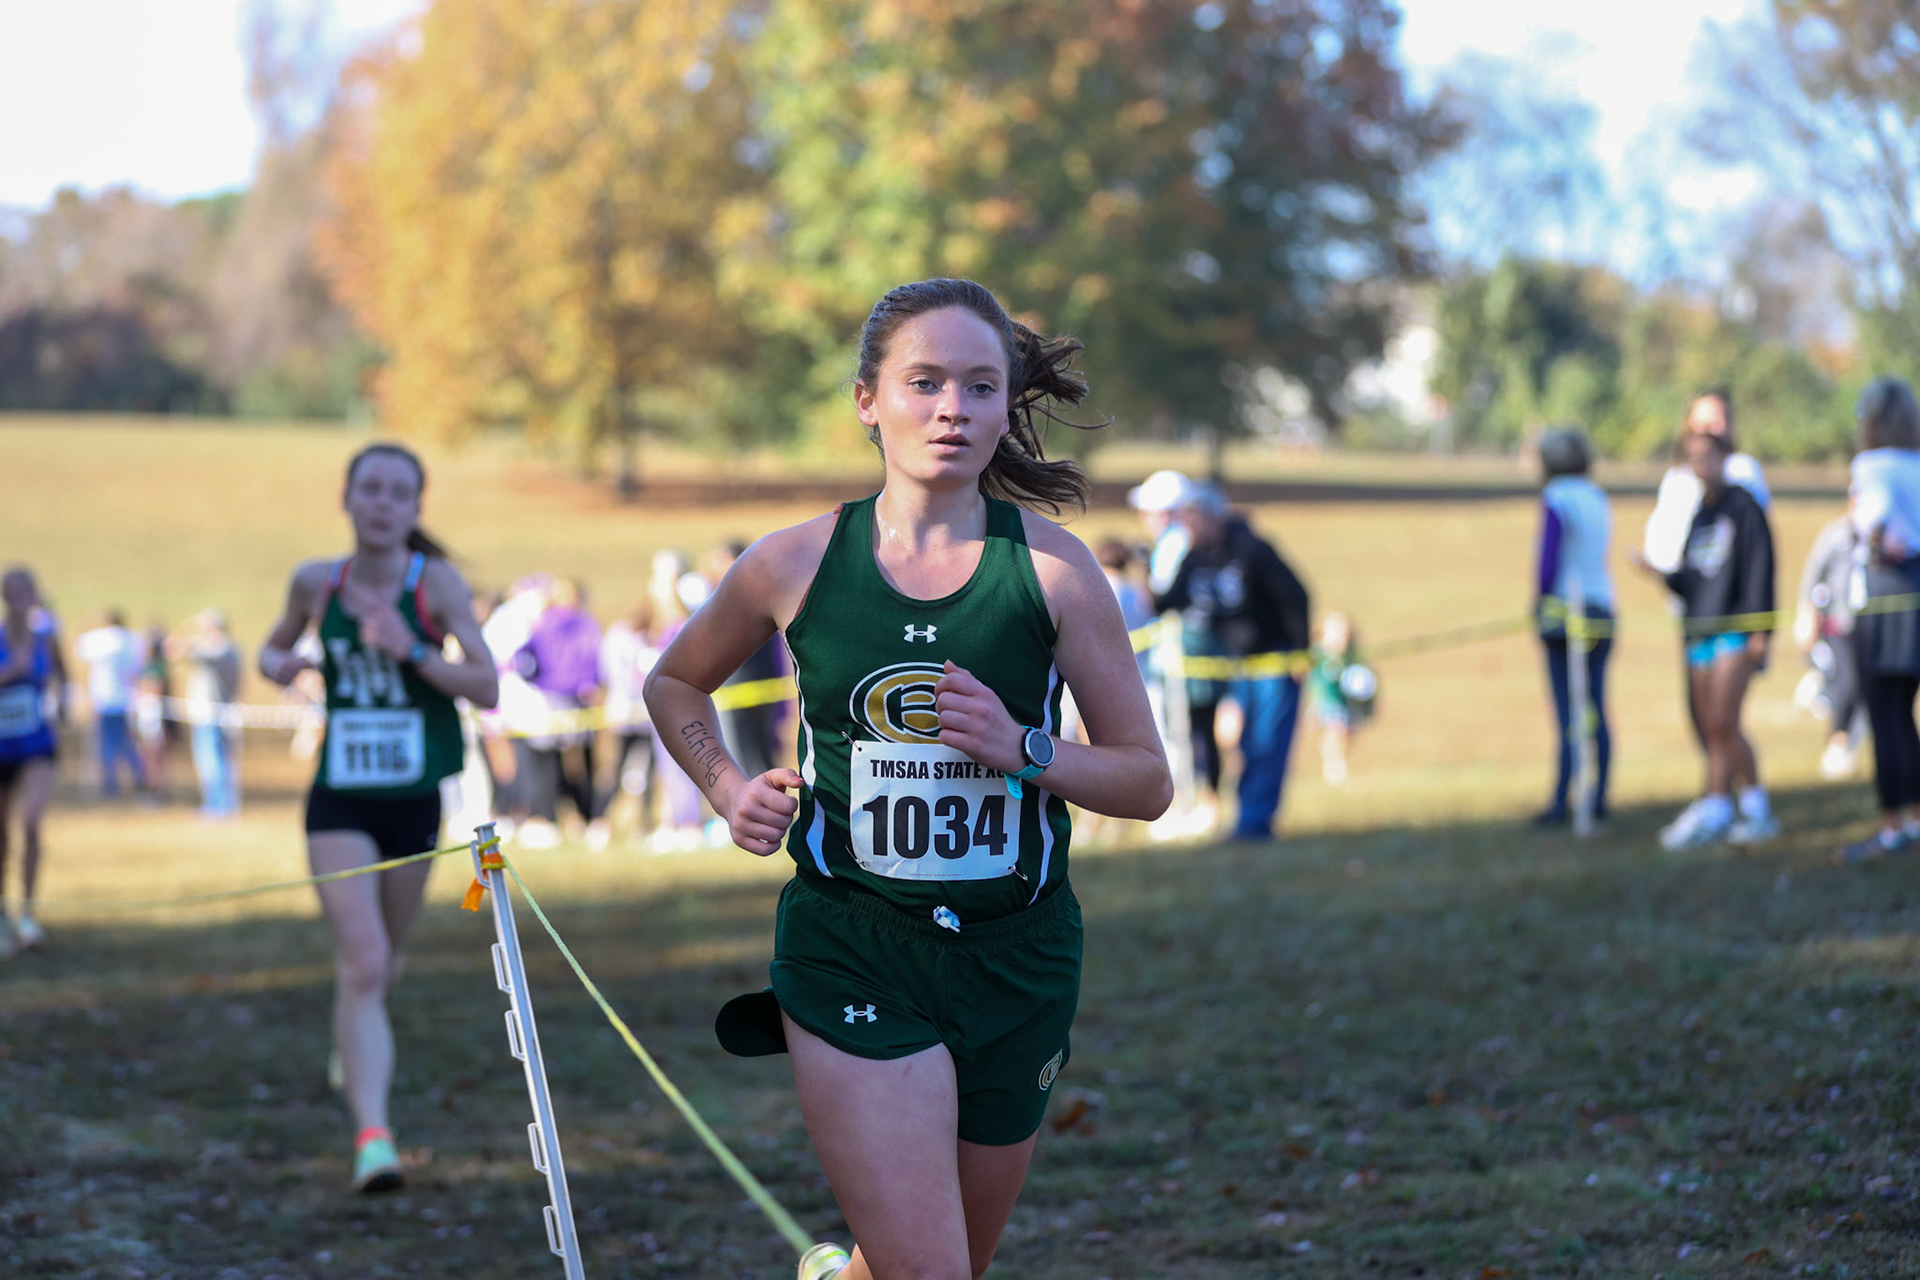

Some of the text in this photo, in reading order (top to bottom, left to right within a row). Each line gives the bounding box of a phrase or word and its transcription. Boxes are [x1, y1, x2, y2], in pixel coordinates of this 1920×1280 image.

[681, 720, 716, 757] 4:13
[870, 759, 930, 780] TMSAA
[933, 761, 982, 780] STATE
[862, 794, 1008, 860] 1034
